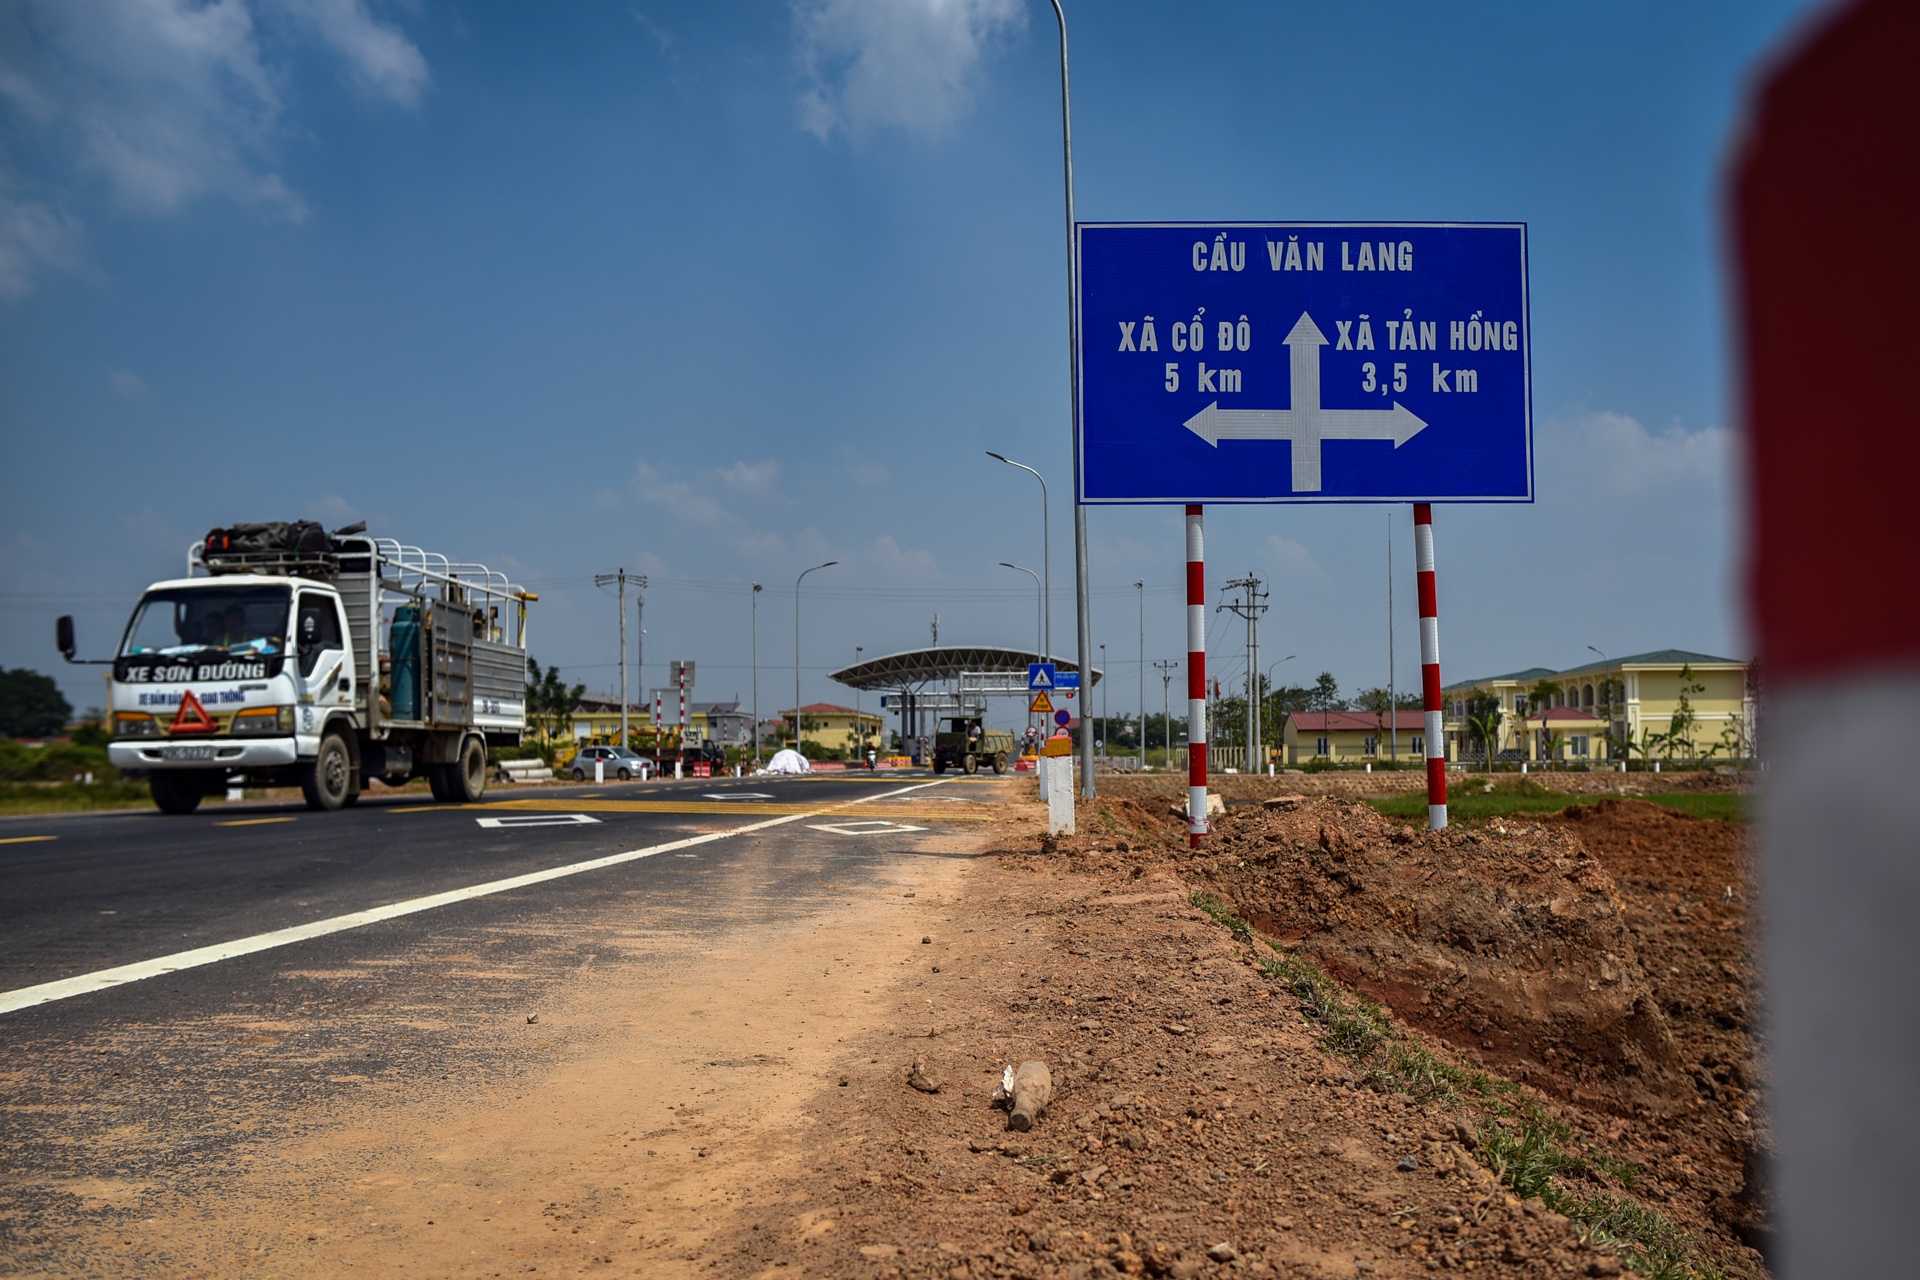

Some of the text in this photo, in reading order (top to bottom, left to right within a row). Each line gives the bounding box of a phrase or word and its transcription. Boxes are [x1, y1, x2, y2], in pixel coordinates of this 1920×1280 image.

[1192, 232, 1413, 271] CẦU VĂN LANG
[1118, 306, 1250, 352] XÃ CỔ ĐÔ
[1335, 308, 1518, 351] XÃ TẢN HỒNG
[1164, 362, 1242, 392] 5 km
[1361, 362, 1478, 396] 3,5 km
[125, 660, 266, 682] XE SƠN ĐƯỜNG
